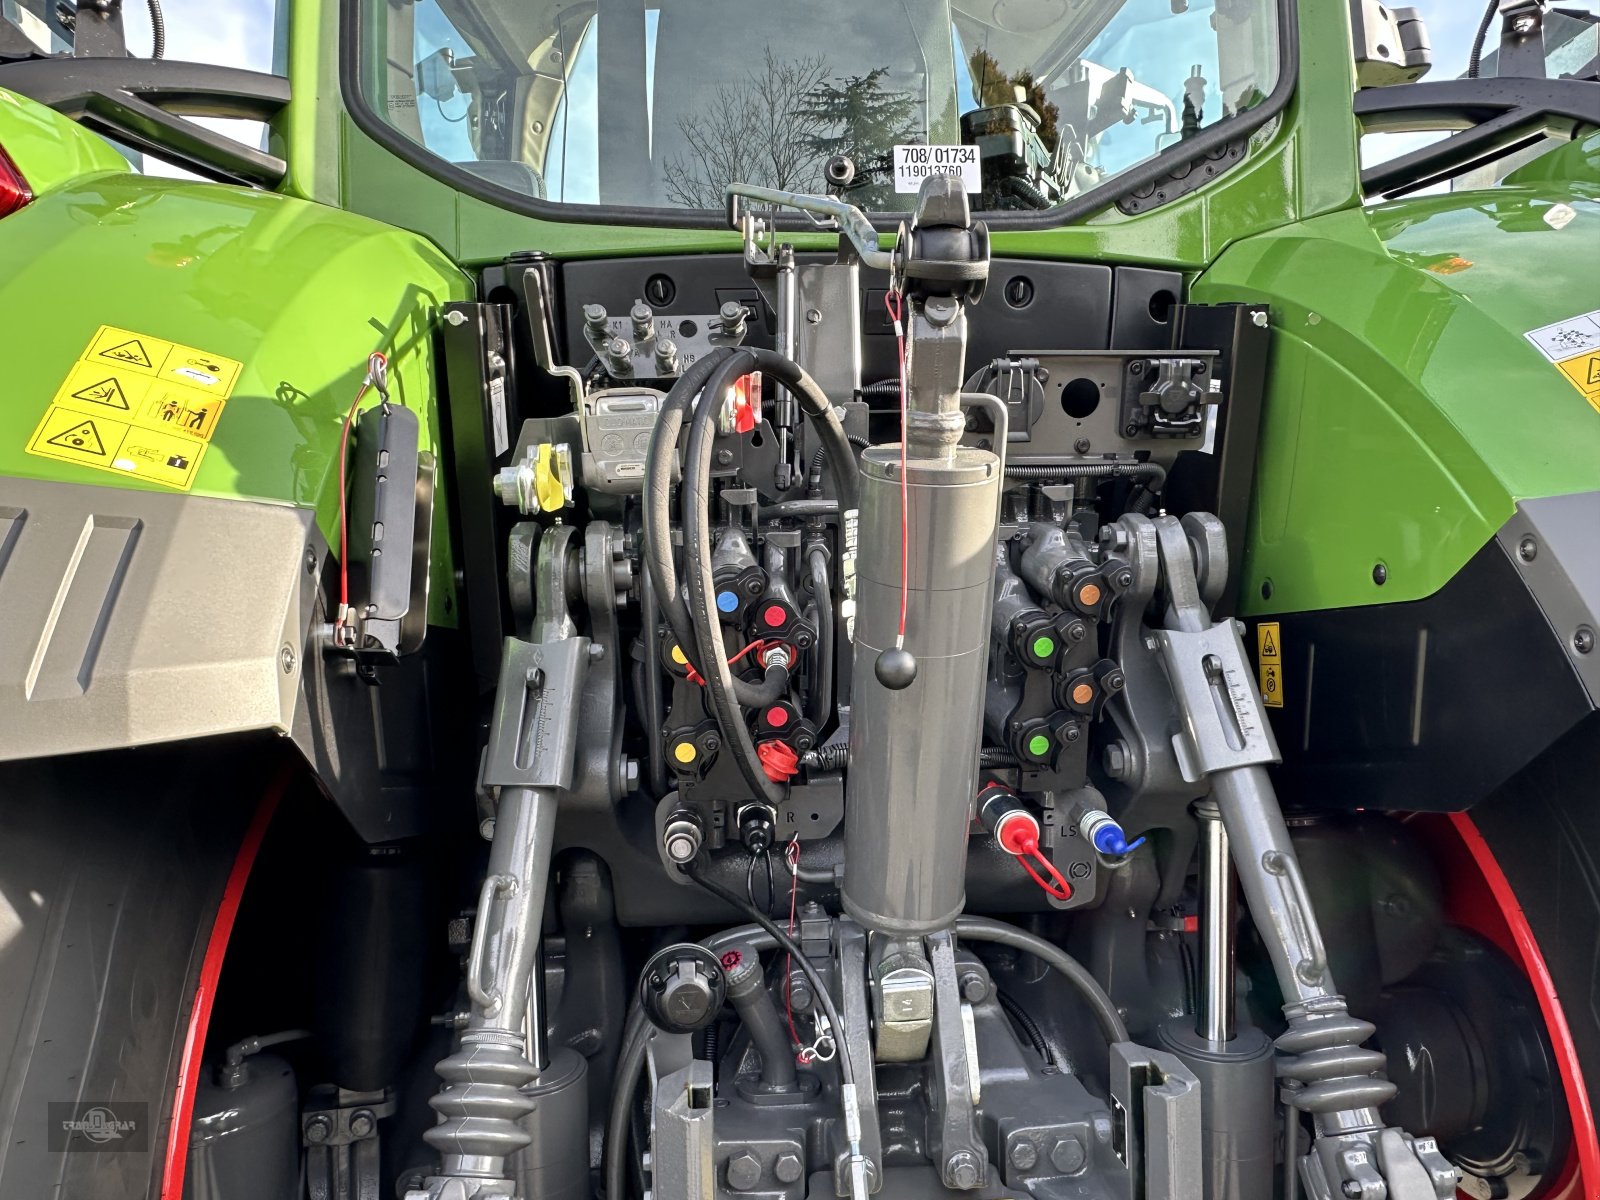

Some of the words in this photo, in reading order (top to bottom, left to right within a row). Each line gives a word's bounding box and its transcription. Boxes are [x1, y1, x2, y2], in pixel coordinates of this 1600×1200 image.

[902, 147, 932, 164] 708/
[935, 148, 976, 163] 01734
[898, 165, 962, 177] 119013760
[660, 320, 672, 328] HA
[786, 811, 795, 823] R
[1061, 825, 1077, 837] LS
